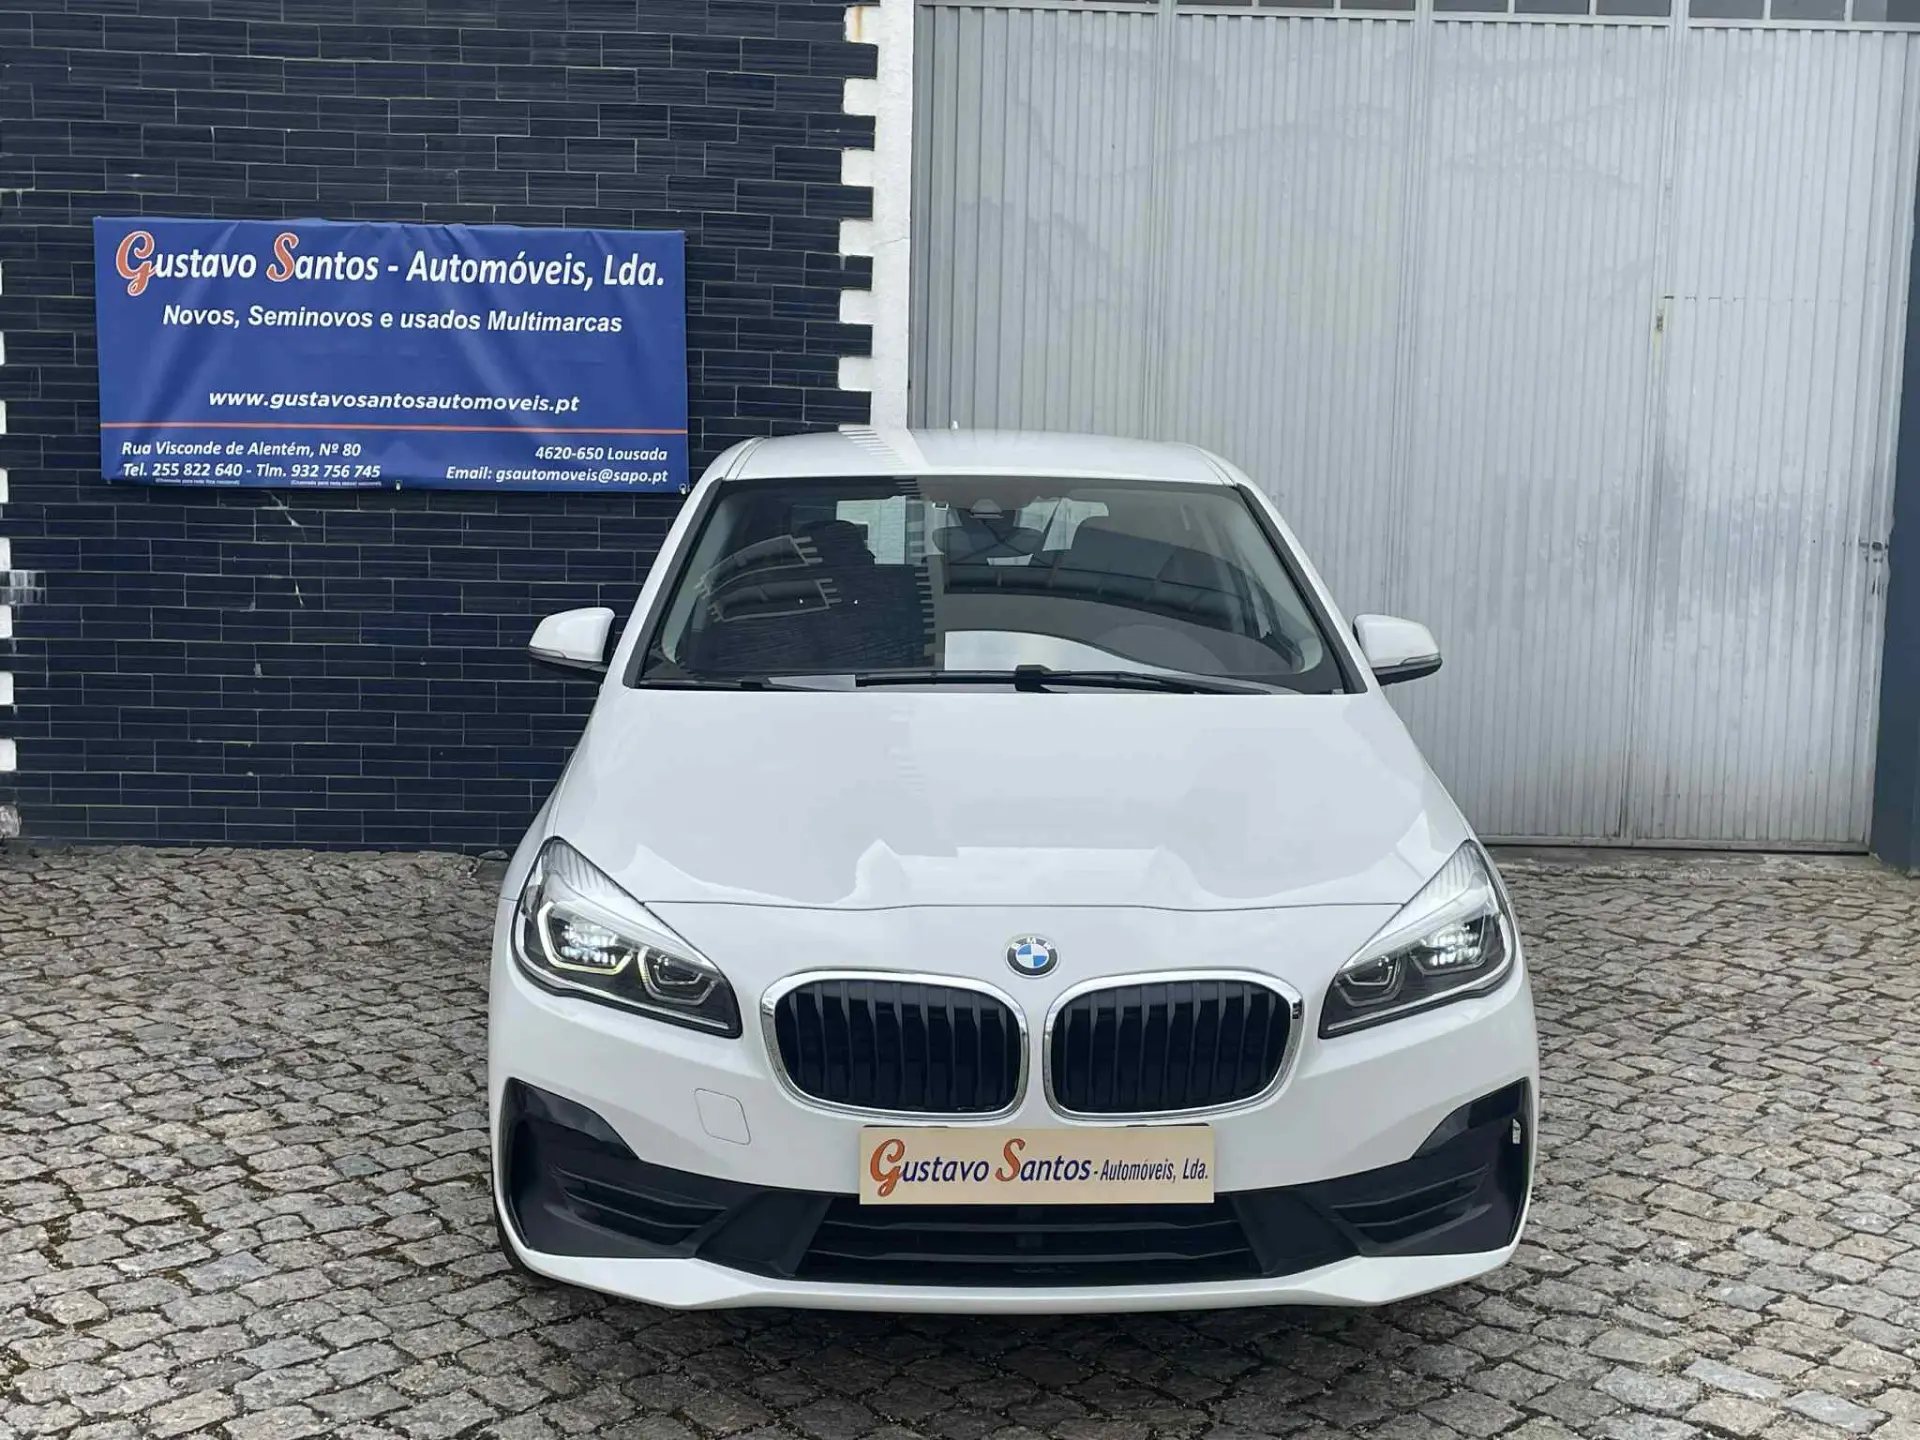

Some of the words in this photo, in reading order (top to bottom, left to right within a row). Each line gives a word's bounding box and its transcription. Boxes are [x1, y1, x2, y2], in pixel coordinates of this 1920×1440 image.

[115, 231, 256, 296] Gustavo
[266, 233, 379, 283] Santos
[406, 250, 593, 291] Automóveis,
[604, 254, 664, 286] Lda.
[163, 305, 240, 329] Novos,
[248, 306, 373, 327] Seminovos
[380, 313, 393, 326] e
[400, 310, 480, 329] usados
[488, 311, 622, 332] Multimarcas
[209, 392, 579, 414] www.gustavosantosautomoveis.pt
[122, 442, 151, 455] Rua
[156, 442, 221, 455] Visconde
[226, 442, 243, 455] de
[248, 442, 314, 458] Alentém,
[343, 443, 361, 457] 80
[536, 446, 603, 460] 4620-650
[608, 447, 667, 461] Lousada
[123, 463, 147, 476] Tel.
[153, 463, 178, 476] 255
[183, 463, 210, 476] 822
[215, 463, 242, 476] 640
[257, 464, 286, 477] Tlm.
[292, 464, 318, 477] 932
[323, 464, 349, 477] 756
[354, 464, 380, 477] 745
[446, 467, 492, 480] Email:
[496, 468, 668, 483] gsautomoveis@sapo.pt
[870, 1138, 989, 1197] Gustavo
[995, 1138, 1091, 1182] Santos
[1100, 1159, 1176, 1184] Automóveis,
[1182, 1158, 1208, 1180] Lda.
